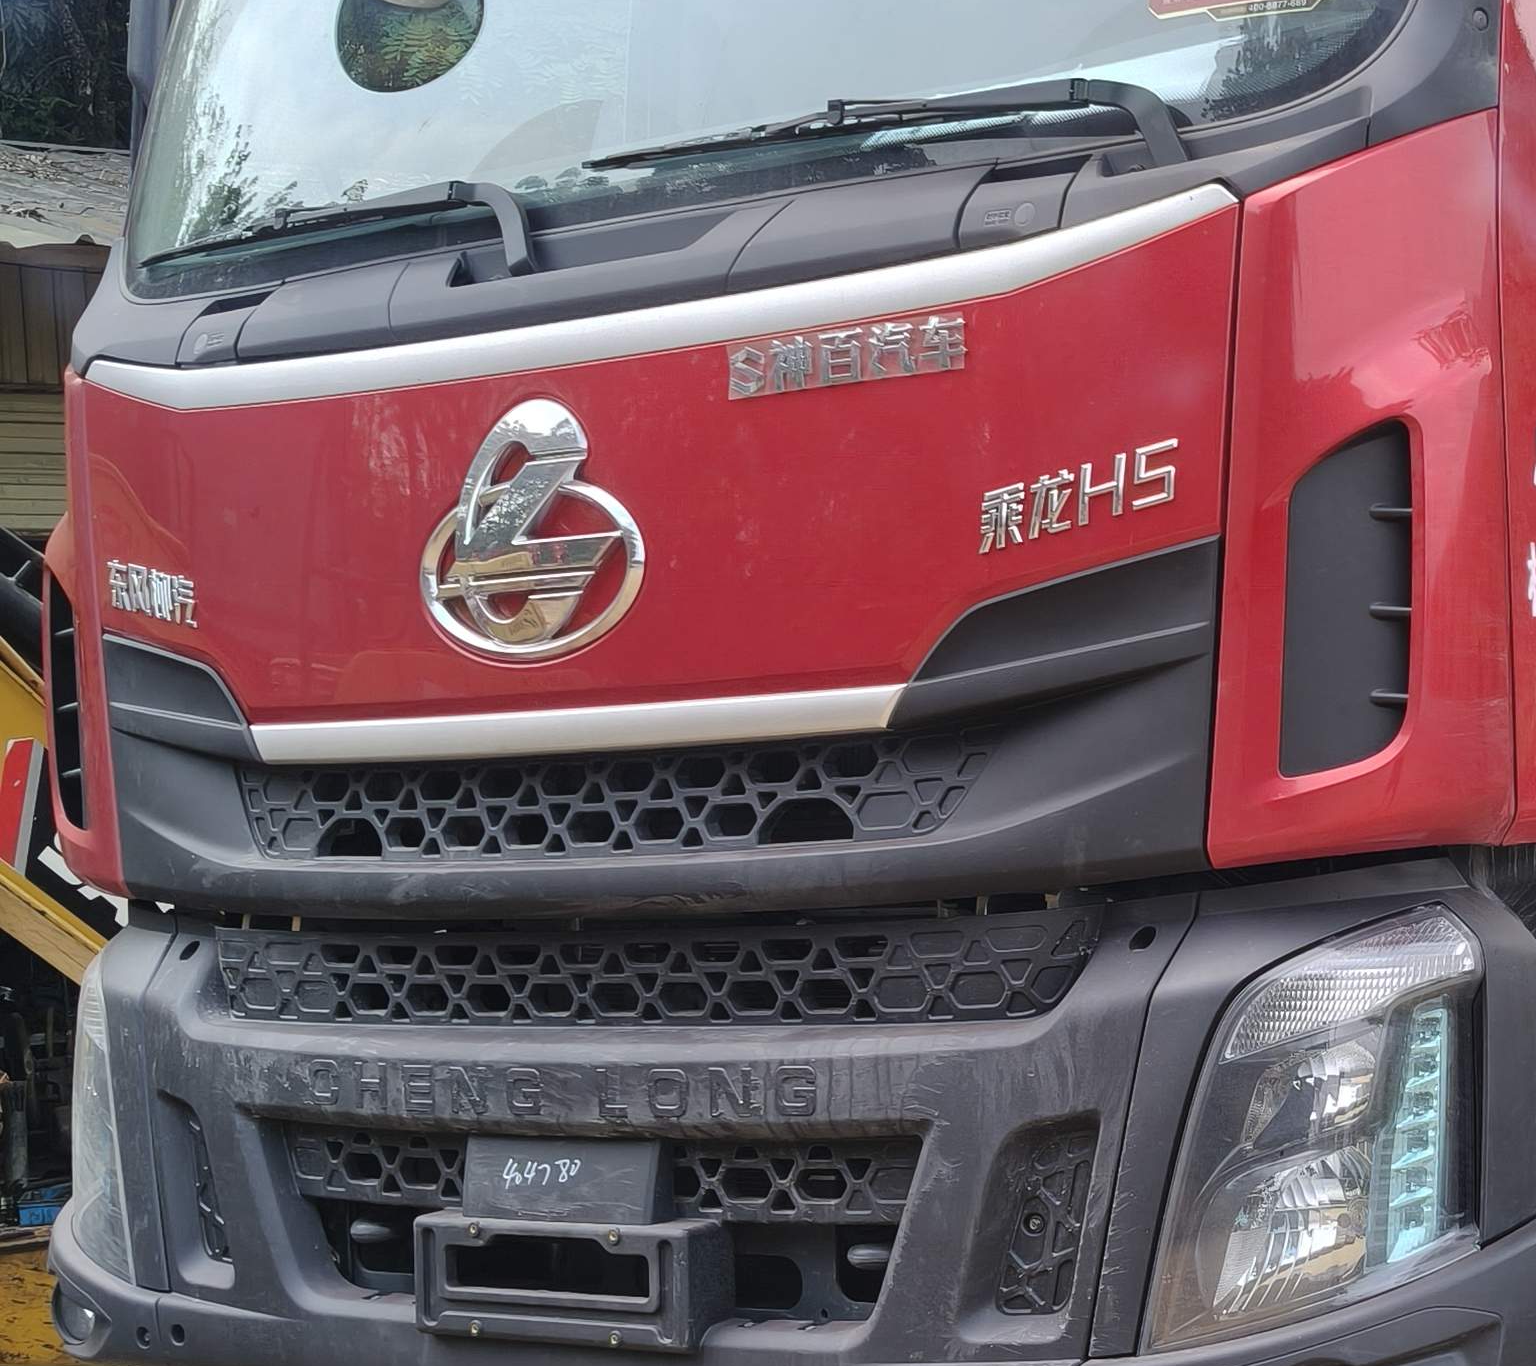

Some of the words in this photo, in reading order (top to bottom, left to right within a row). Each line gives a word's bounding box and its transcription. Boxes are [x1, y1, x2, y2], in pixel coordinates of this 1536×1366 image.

[770, 315, 968, 392] 神百汽车
[978, 438, 1179, 555] 乘龙H5
[107, 559, 198, 628] 东风柳汽
[306, 1057, 545, 1116] CHENG
[596, 1064, 817, 1119] LONG
